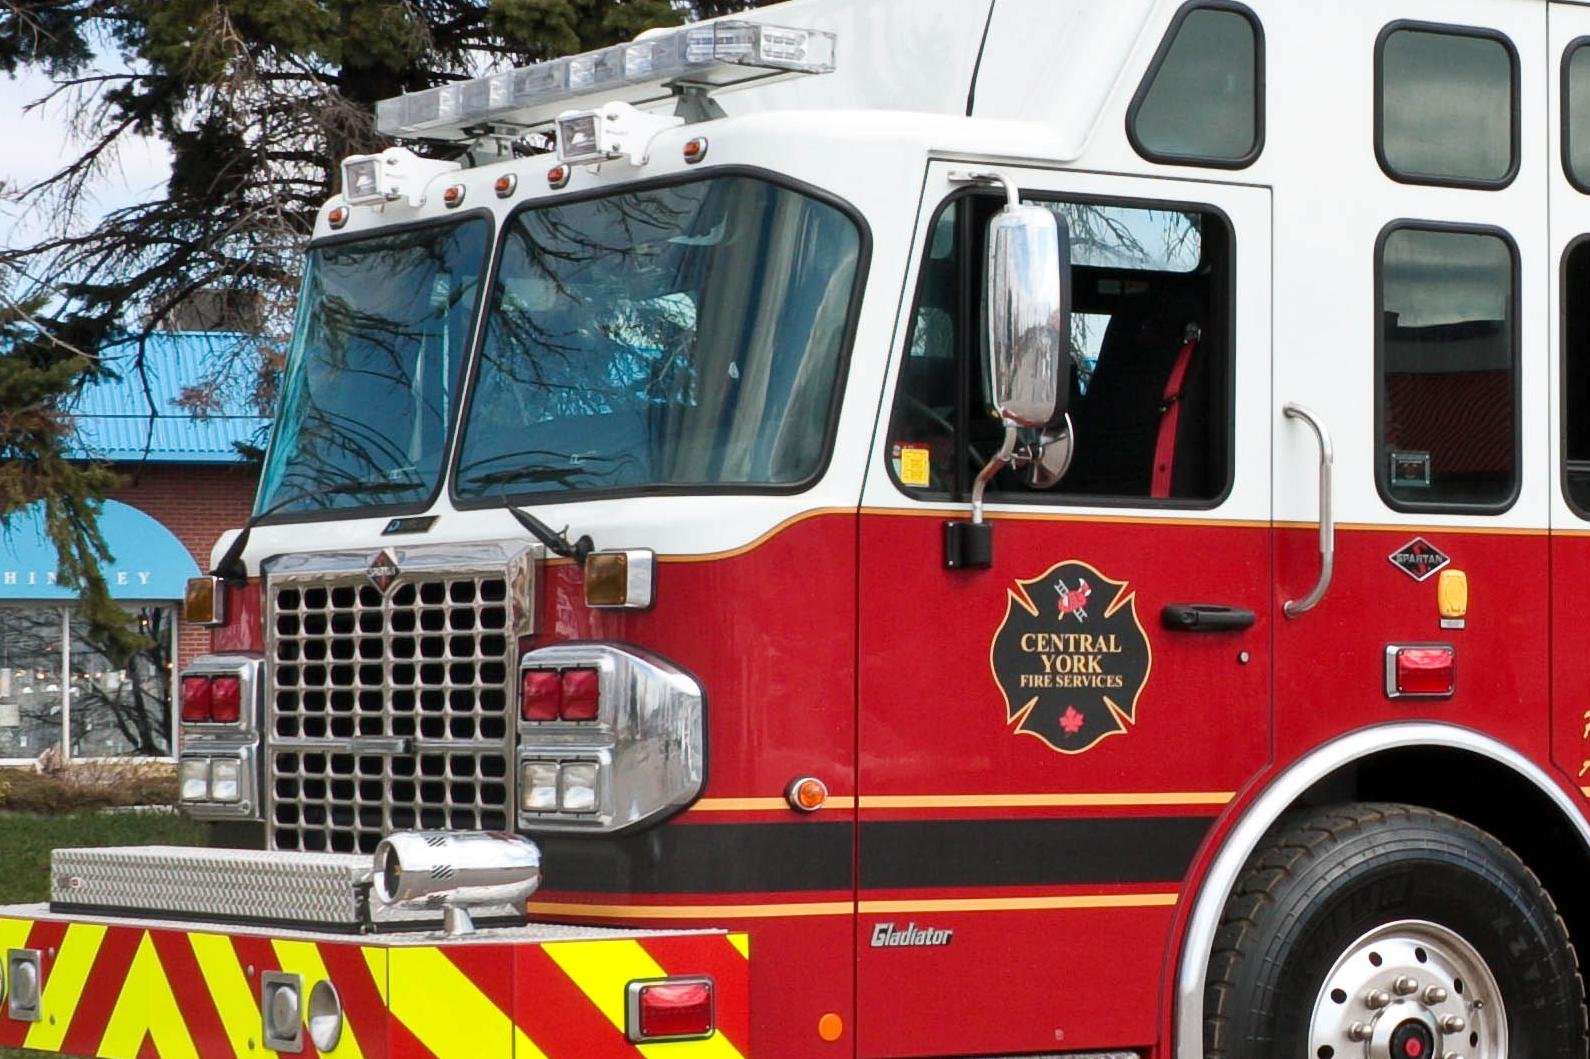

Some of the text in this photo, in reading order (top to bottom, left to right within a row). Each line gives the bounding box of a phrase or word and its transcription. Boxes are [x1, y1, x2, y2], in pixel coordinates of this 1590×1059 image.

[1396, 553, 1443, 564] SPARTAN
[1020, 633, 1122, 653] CENTRAL
[1041, 654, 1103, 674] YORK
[1020, 674, 1123, 688] FIRE SERVICES
[870, 922, 954, 947] Gladiator
